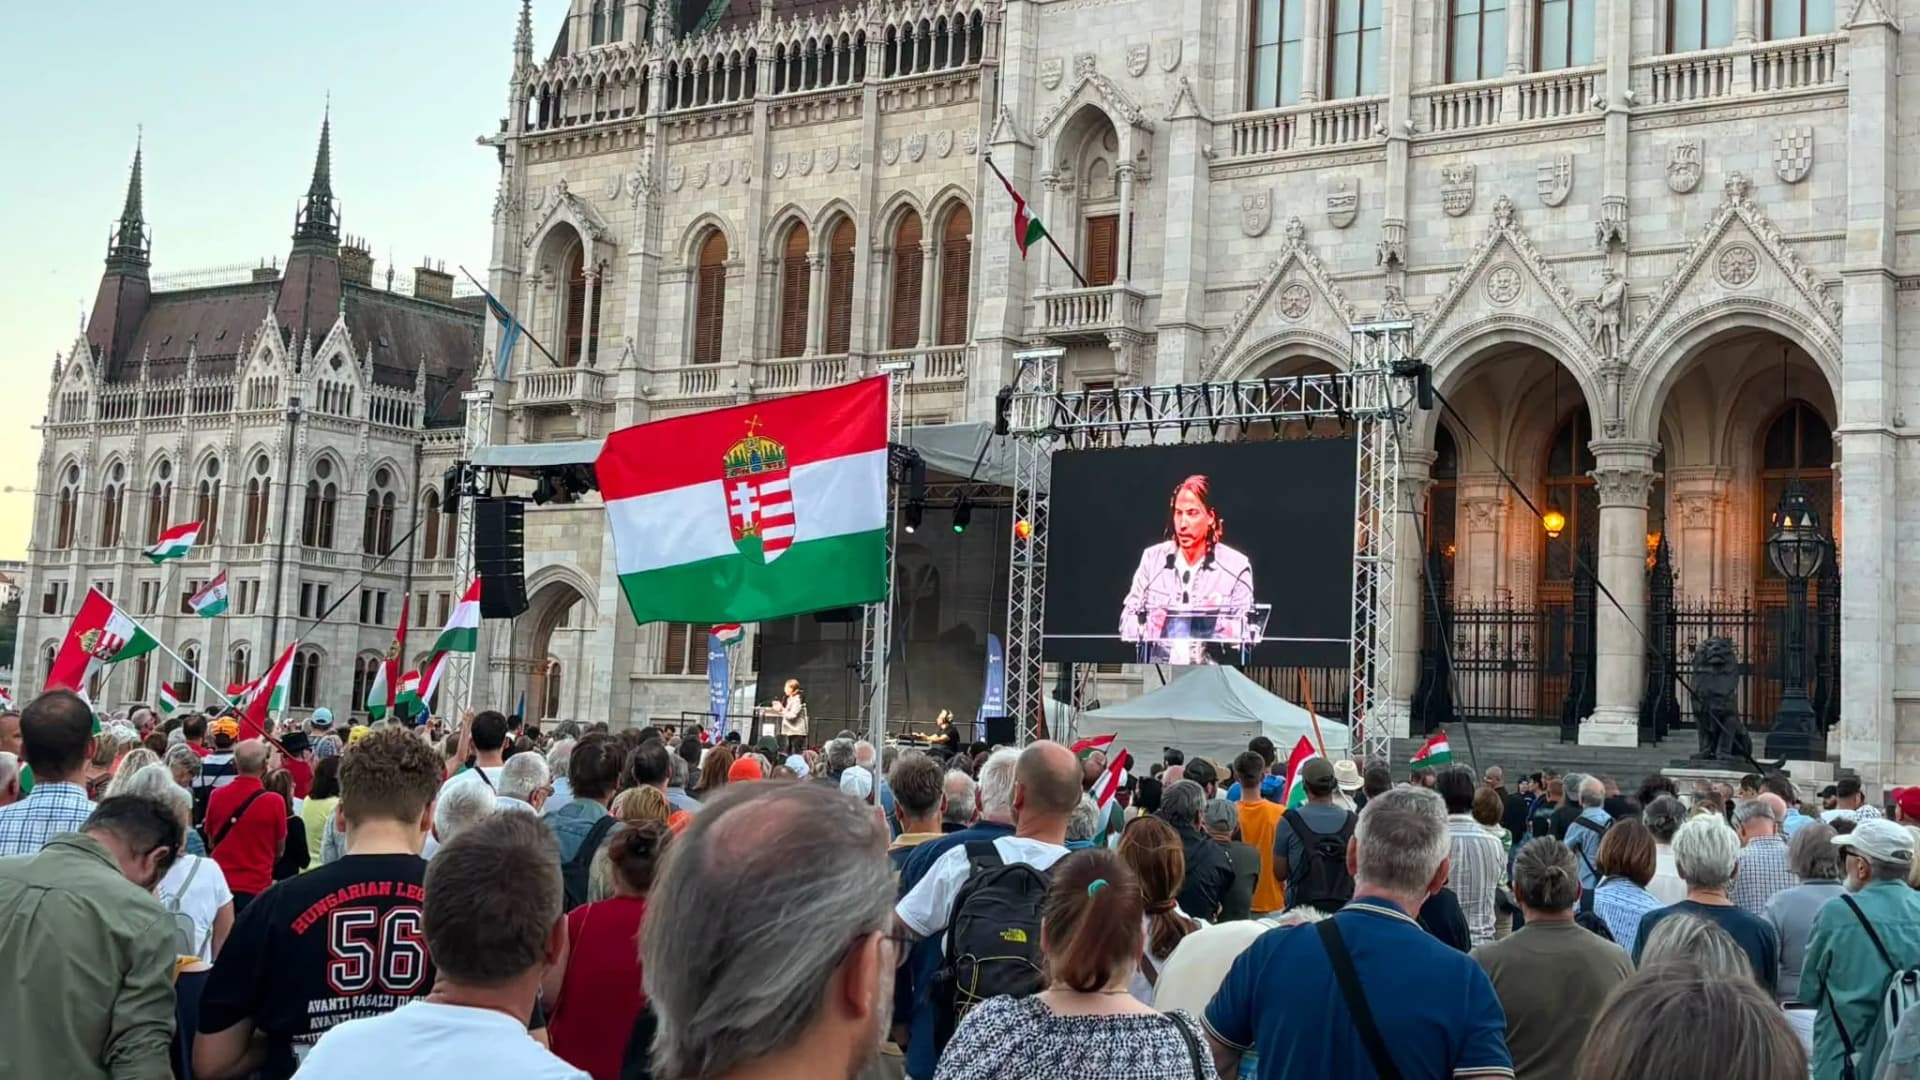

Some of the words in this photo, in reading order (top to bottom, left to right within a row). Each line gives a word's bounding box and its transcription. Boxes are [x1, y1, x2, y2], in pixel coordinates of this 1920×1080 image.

[290, 881, 393, 935] HUNGARIAN
[327, 906, 428, 995] 56
[307, 996, 350, 1013] AVANTI
